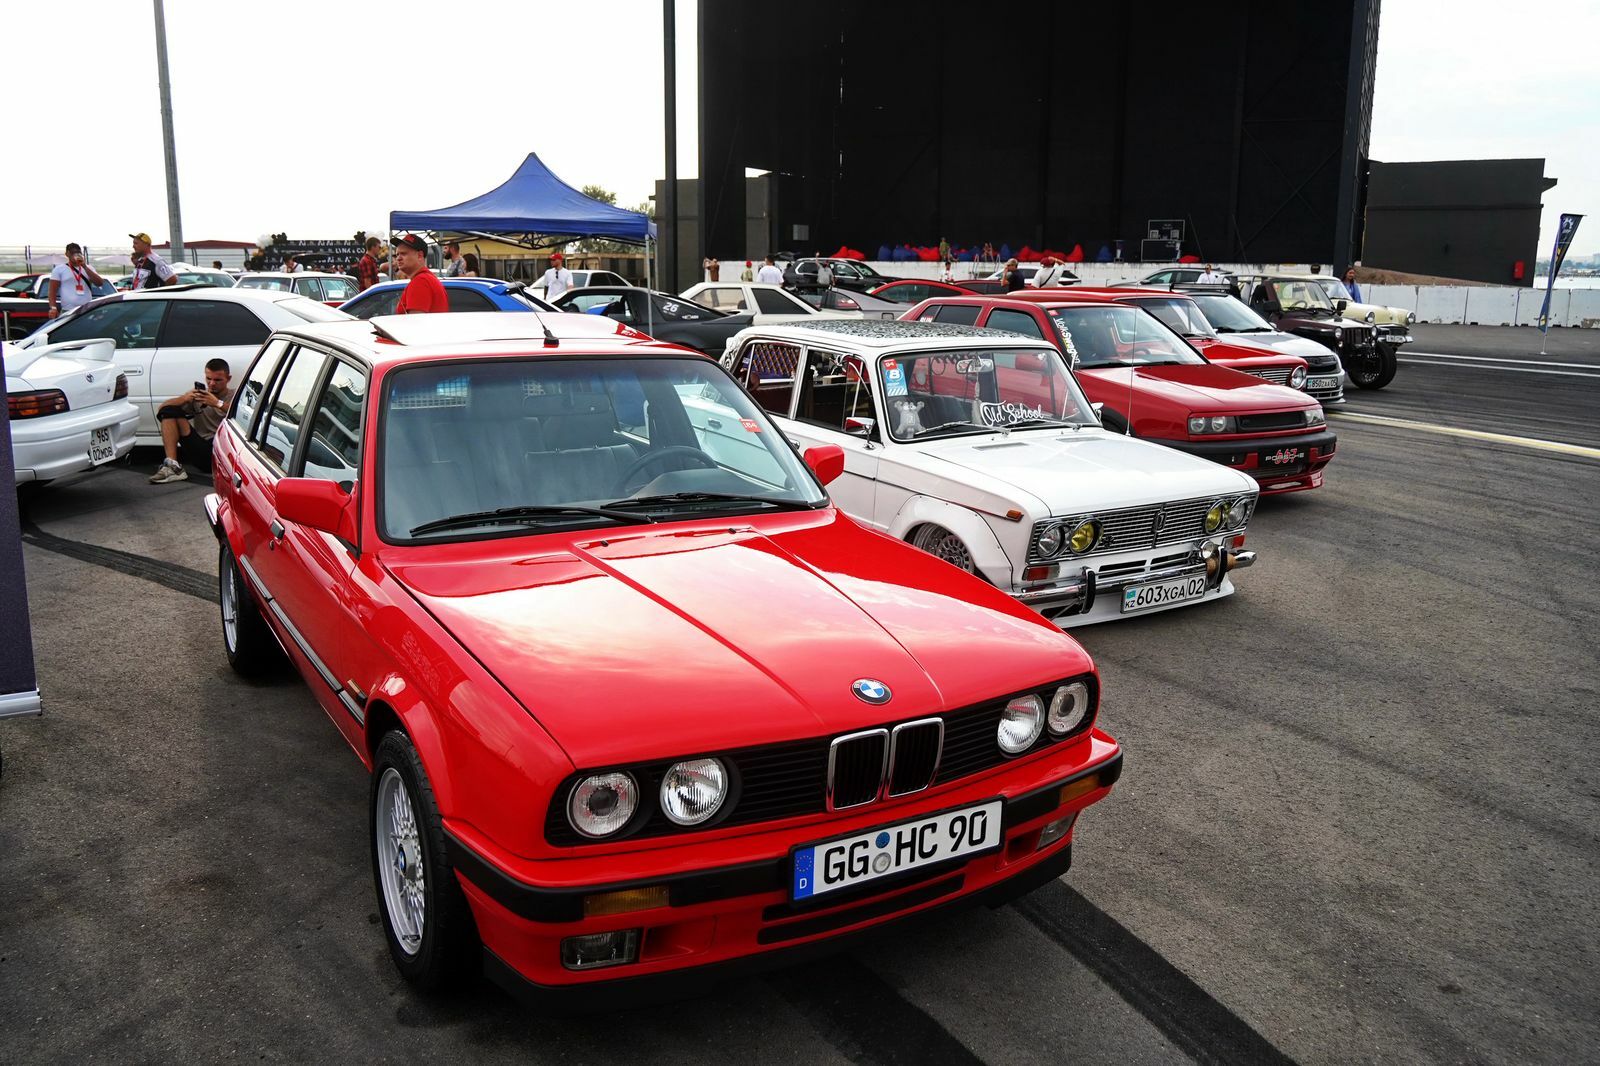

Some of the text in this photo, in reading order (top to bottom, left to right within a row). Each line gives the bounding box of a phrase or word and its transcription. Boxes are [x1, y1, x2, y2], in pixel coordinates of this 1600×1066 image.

[662, 302, 679, 312] 26
[980, 400, 1044, 427] Old School
[97, 428, 109, 443] 965
[1136, 578, 1204, 606] 603XGA 02
[1125, 600, 1135, 608] KZ
[824, 810, 987, 884] GG HC 90
[799, 877, 808, 890] D
